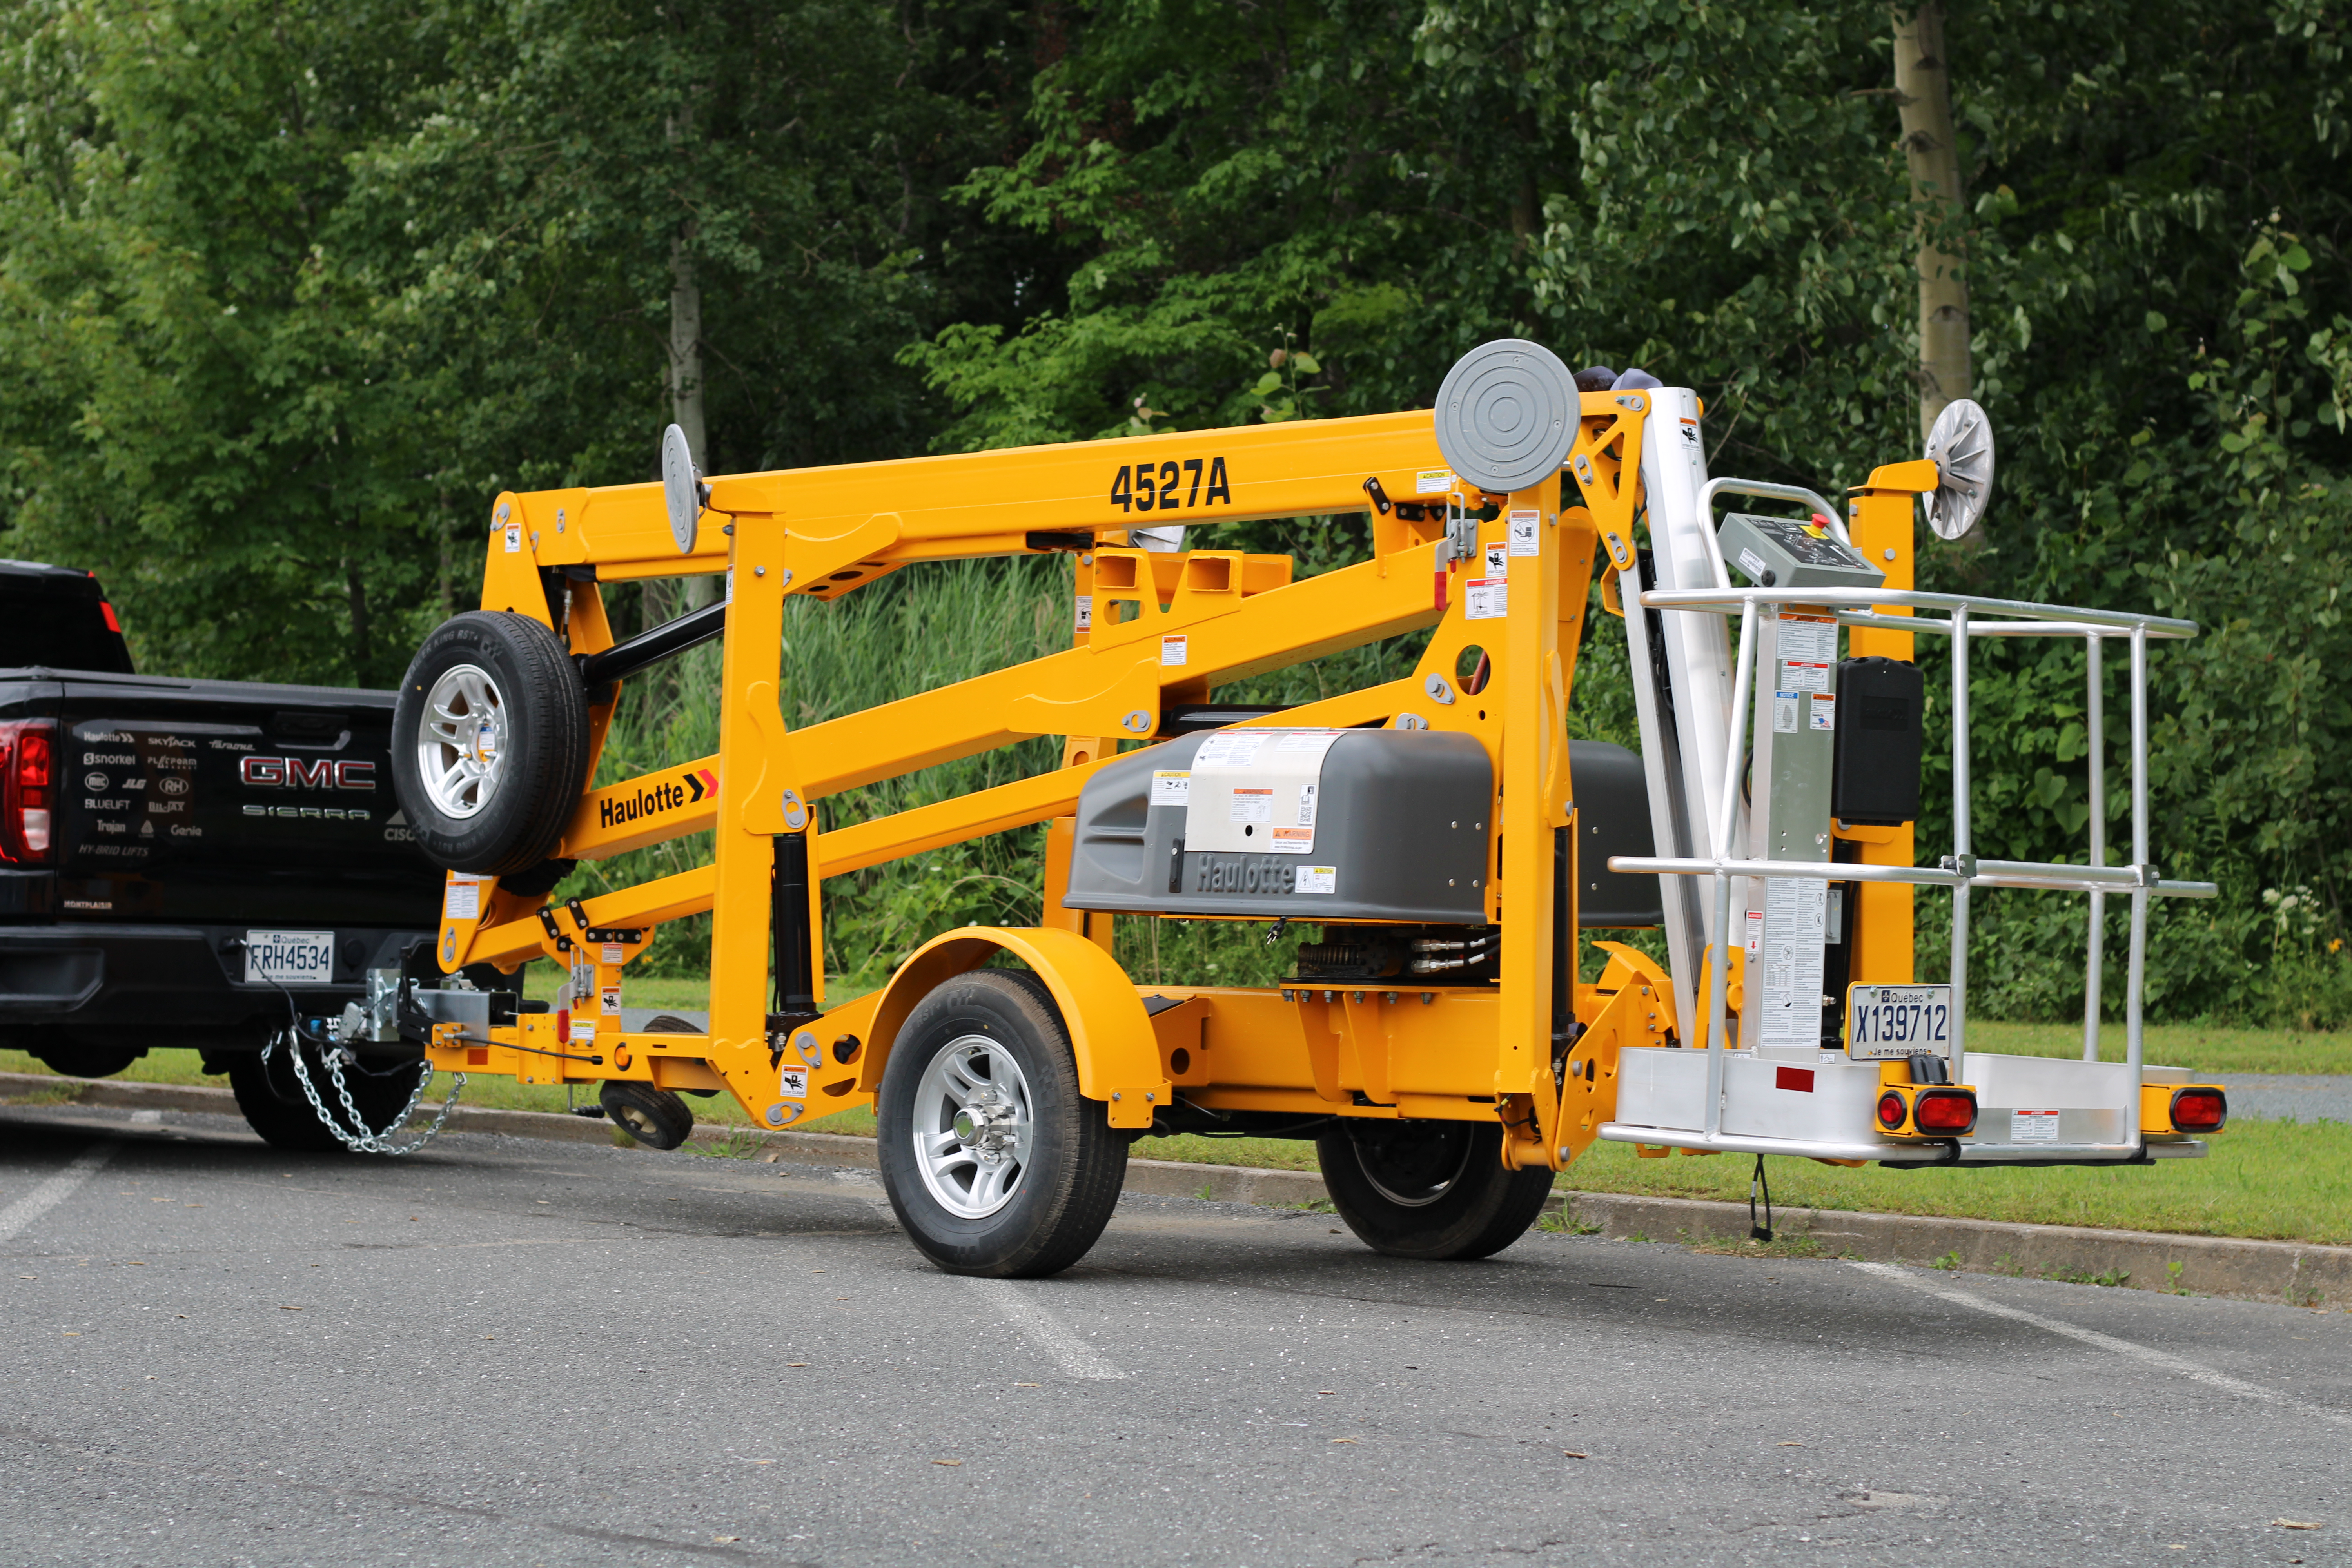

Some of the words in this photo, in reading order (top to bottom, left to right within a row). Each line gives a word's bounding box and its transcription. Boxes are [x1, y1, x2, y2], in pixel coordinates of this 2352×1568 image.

[1111, 457, 1231, 513] 4527A
[84, 731, 120, 742] Haulotte
[148, 736, 196, 747] SKYJACK
[95, 755, 135, 765] snorkel
[240, 756, 376, 789] GMC
[85, 799, 131, 810] BLUELIFT
[599, 782, 684, 829] Haulotte
[243, 805, 370, 820] SIERRA
[97, 819, 125, 834] Trojan
[171, 824, 202, 836] Genie
[79, 844, 119, 855] HY-BRID
[122, 846, 149, 857] LIFTS
[1197, 853, 1295, 894] Haulotte
[250, 945, 329, 970] FRH4534
[1891, 991, 1924, 1002] Québec
[1856, 1005, 1946, 1042] X139712
[1873, 1047, 1881, 1055] Je
[1896, 1046, 1927, 1055] souviens
